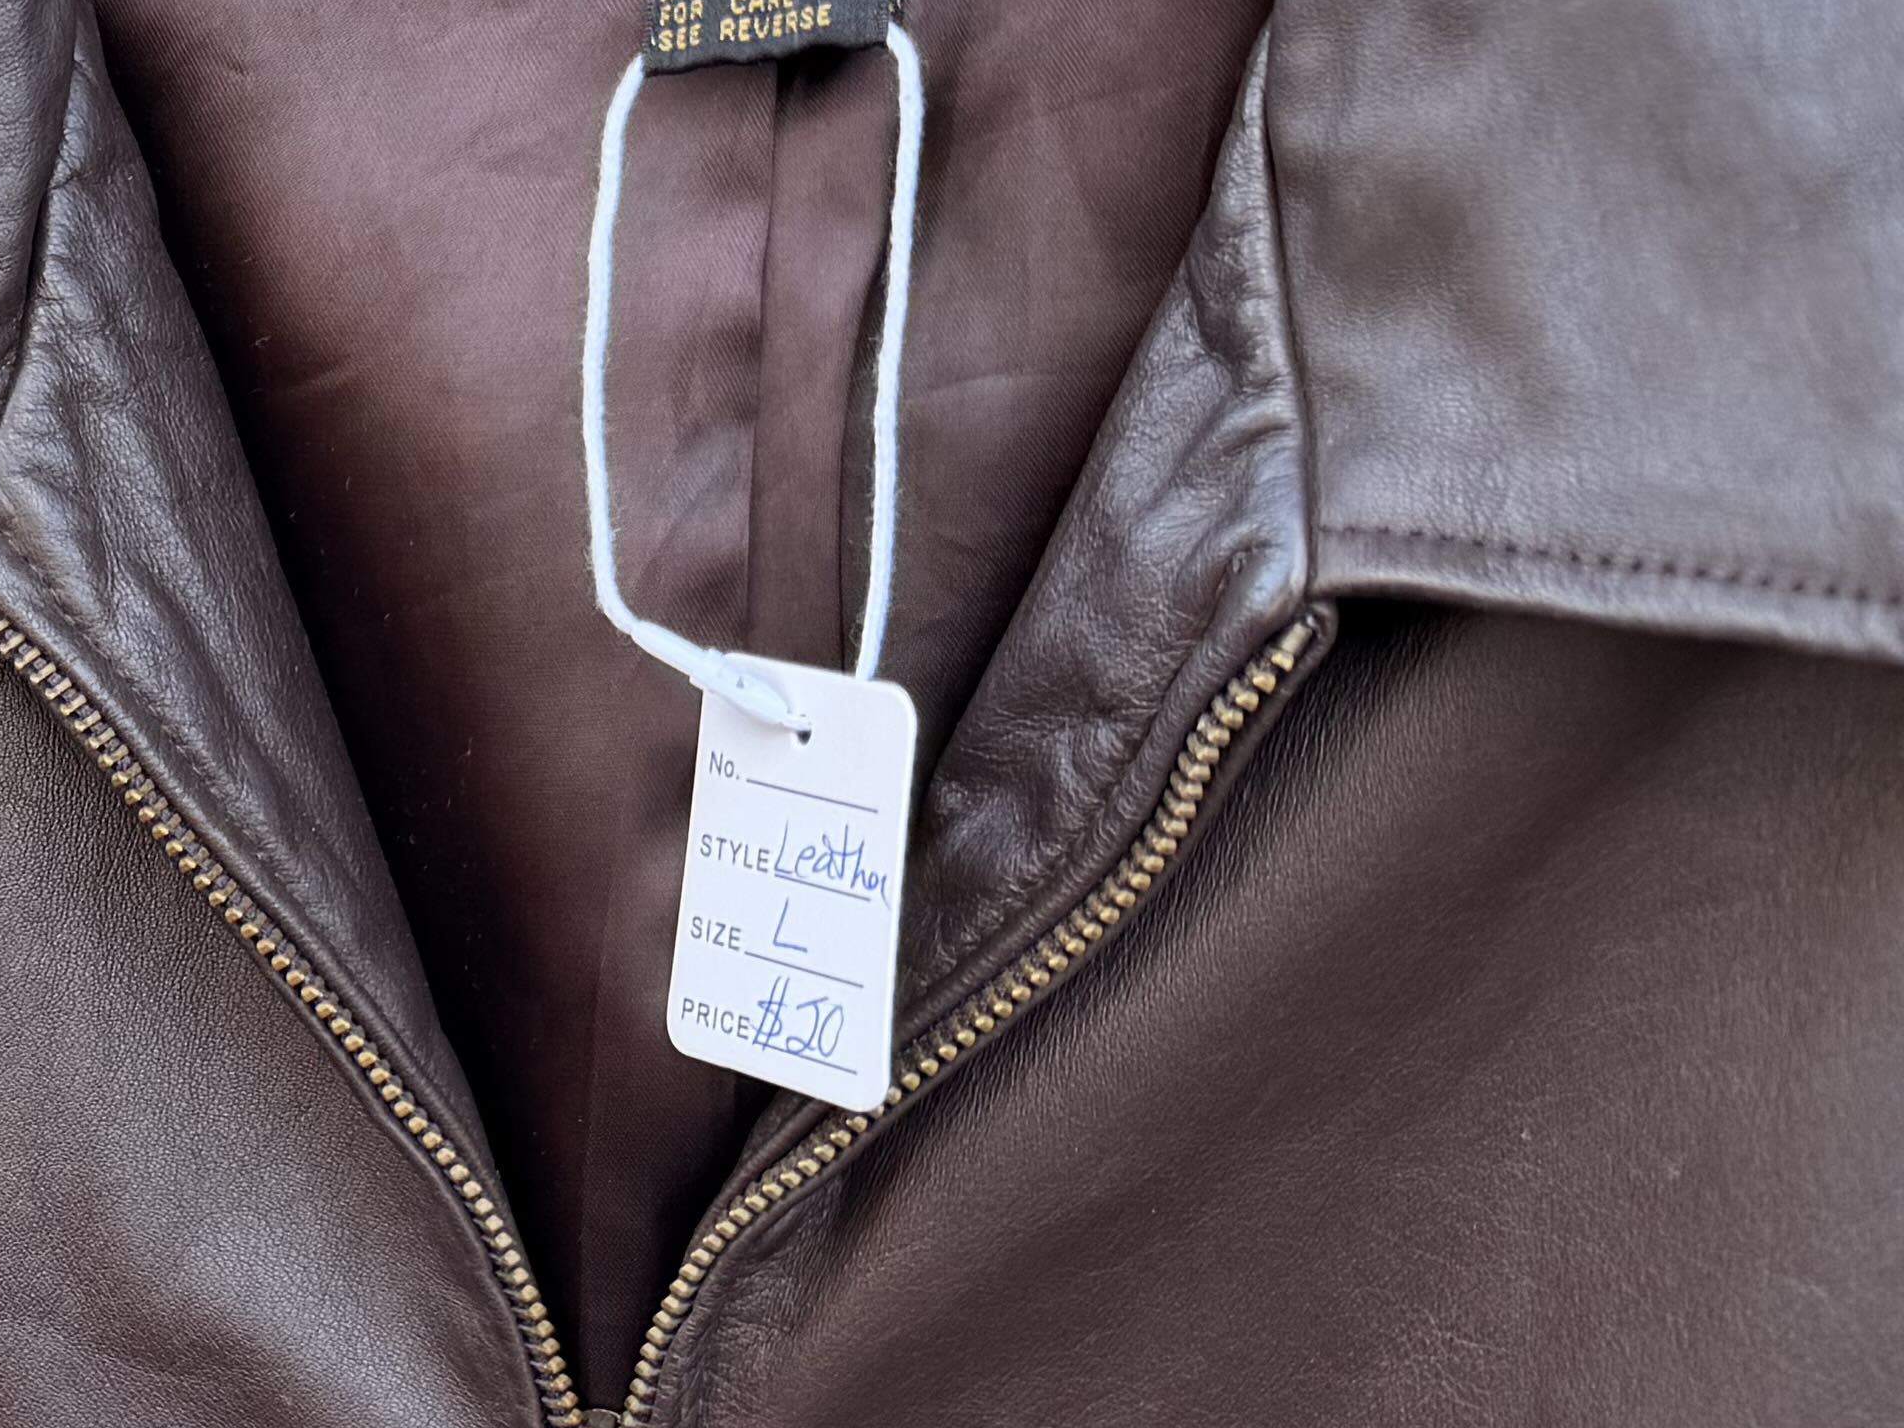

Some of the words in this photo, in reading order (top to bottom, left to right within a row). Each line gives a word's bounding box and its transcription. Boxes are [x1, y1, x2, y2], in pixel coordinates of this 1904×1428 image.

[657, 23, 702, 53] SEE
[719, 3, 833, 43] REVERSE
[708, 750, 741, 781] No.
[699, 833, 771, 873] STYLE
[690, 915, 742, 952] SIZE
[772, 897, 808, 953] L
[681, 997, 751, 1040] PRICE
[750, 975, 845, 1058] $20
